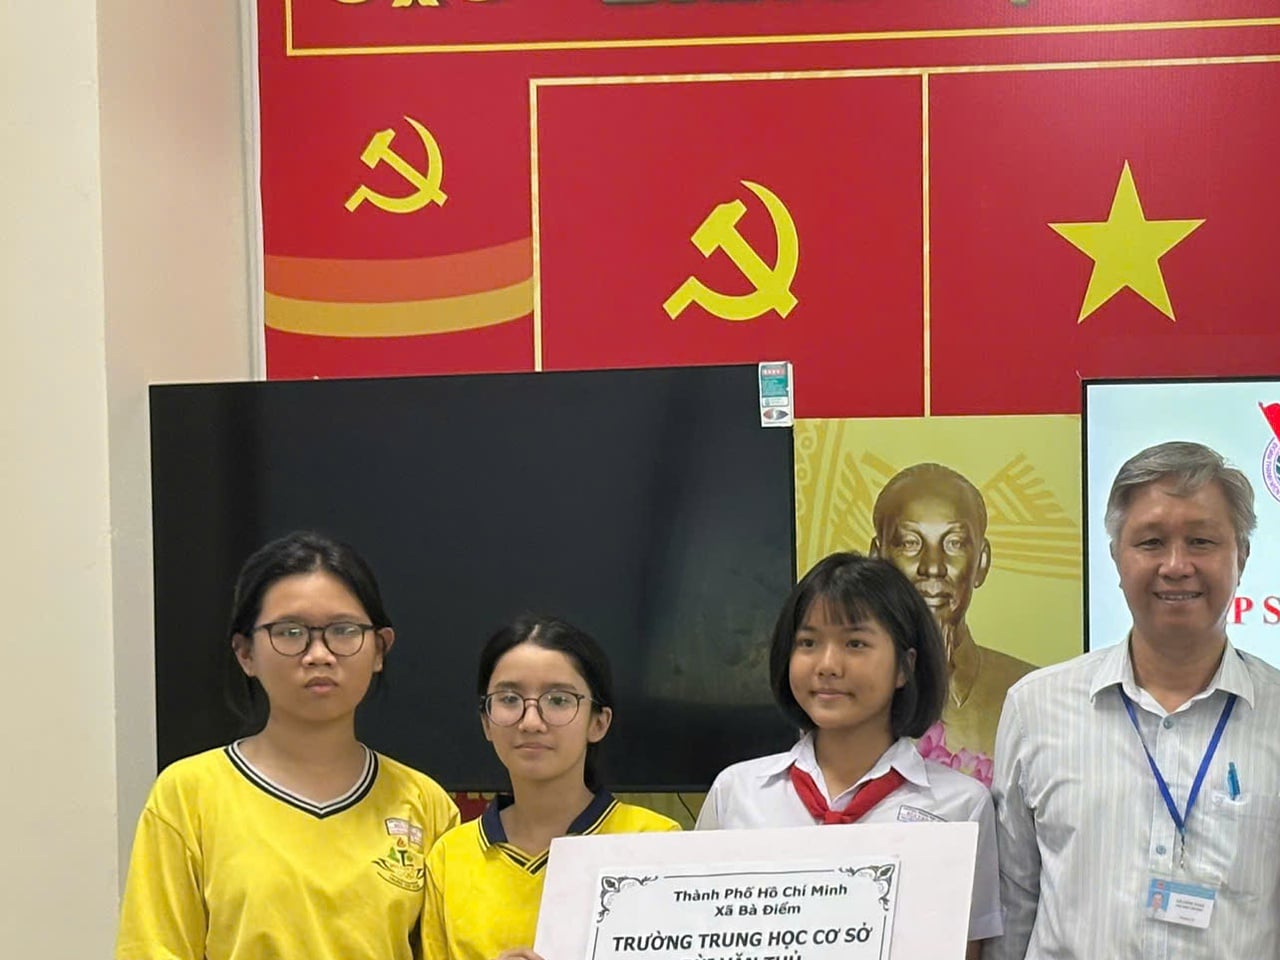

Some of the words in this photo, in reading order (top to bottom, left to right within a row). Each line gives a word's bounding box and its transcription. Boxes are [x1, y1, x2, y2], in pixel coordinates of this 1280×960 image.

[674, 889, 719, 903] Thành
[724, 885, 753, 901] Phố
[757, 886, 778, 900] Hồ
[782, 885, 806, 898] Chí
[811, 884, 848, 897] Minh
[714, 904, 734, 918] Xã
[738, 903, 757, 917] Bà
[612, 929, 693, 953] TRƯỜNG
[698, 931, 762, 950] TRUNG
[768, 929, 808, 950] HỌC
[812, 927, 842, 946] CƠ
[844, 922, 873, 943] SỞ
